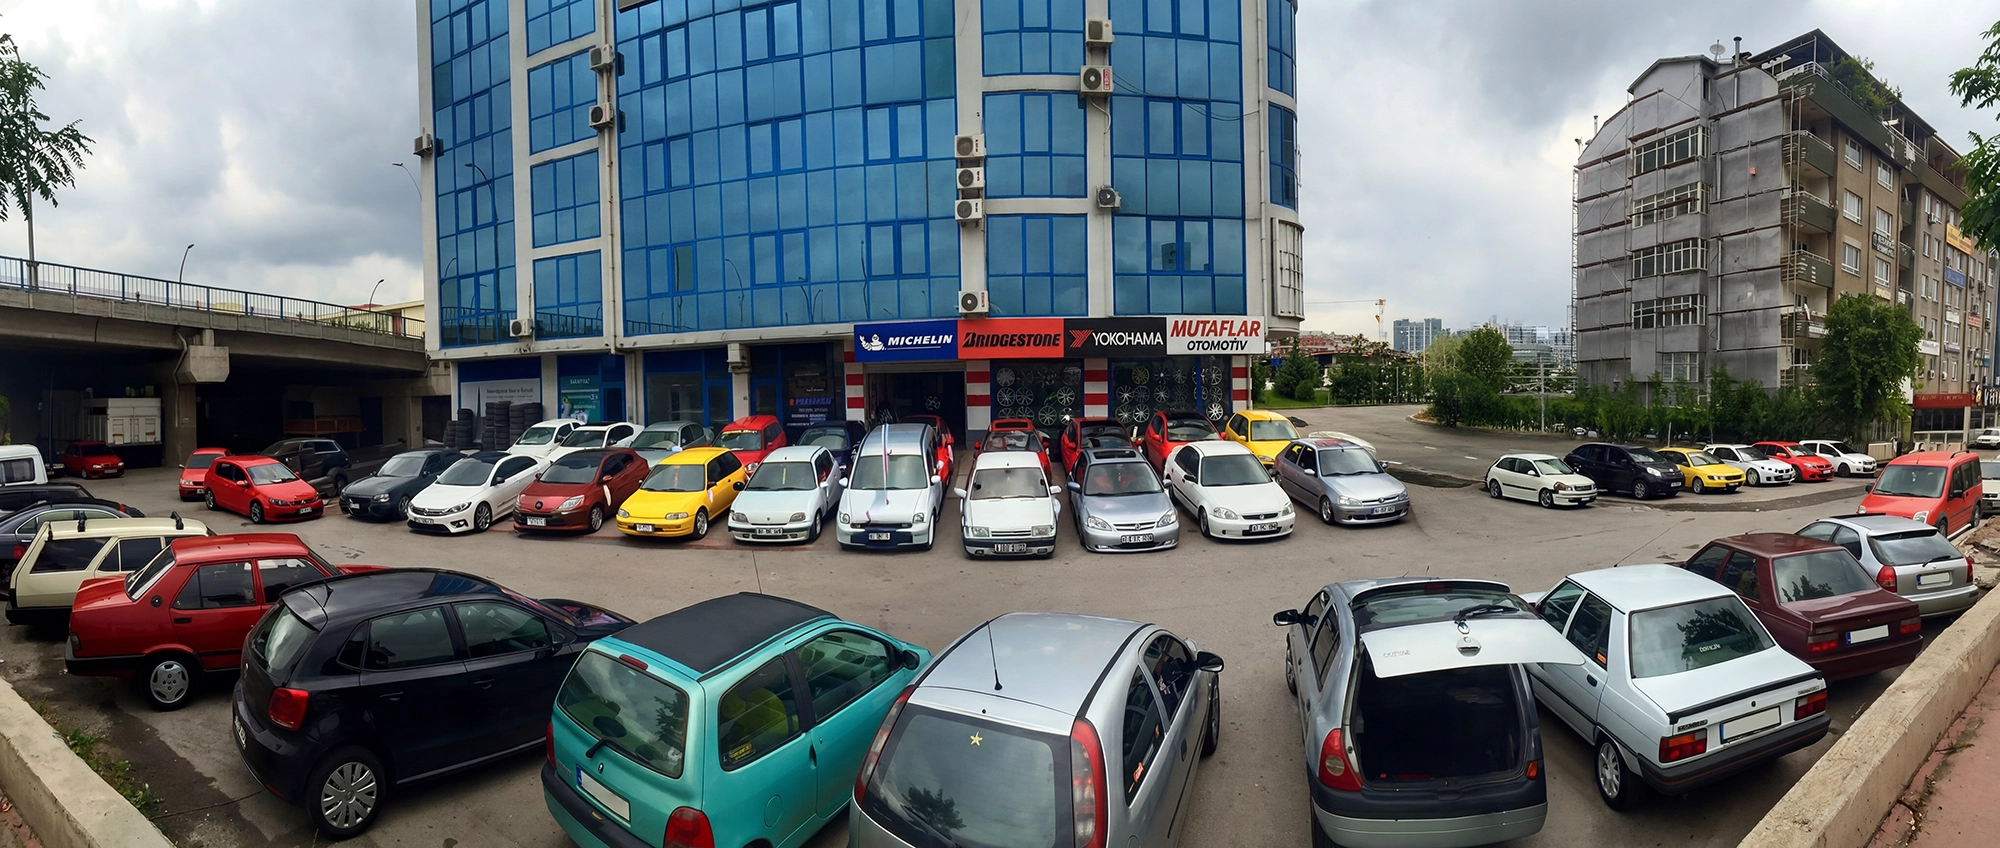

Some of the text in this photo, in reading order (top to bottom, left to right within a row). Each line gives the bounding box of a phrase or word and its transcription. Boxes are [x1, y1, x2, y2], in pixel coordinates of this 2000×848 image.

[1170, 320, 1261, 338] MUTAFLAR
[888, 334, 953, 346] MICHELIN
[962, 332, 1061, 348] BRIDGESTONE
[1091, 332, 1164, 346] YOKOHAMA
[1187, 338, 1248, 351] OTOMOTİV
